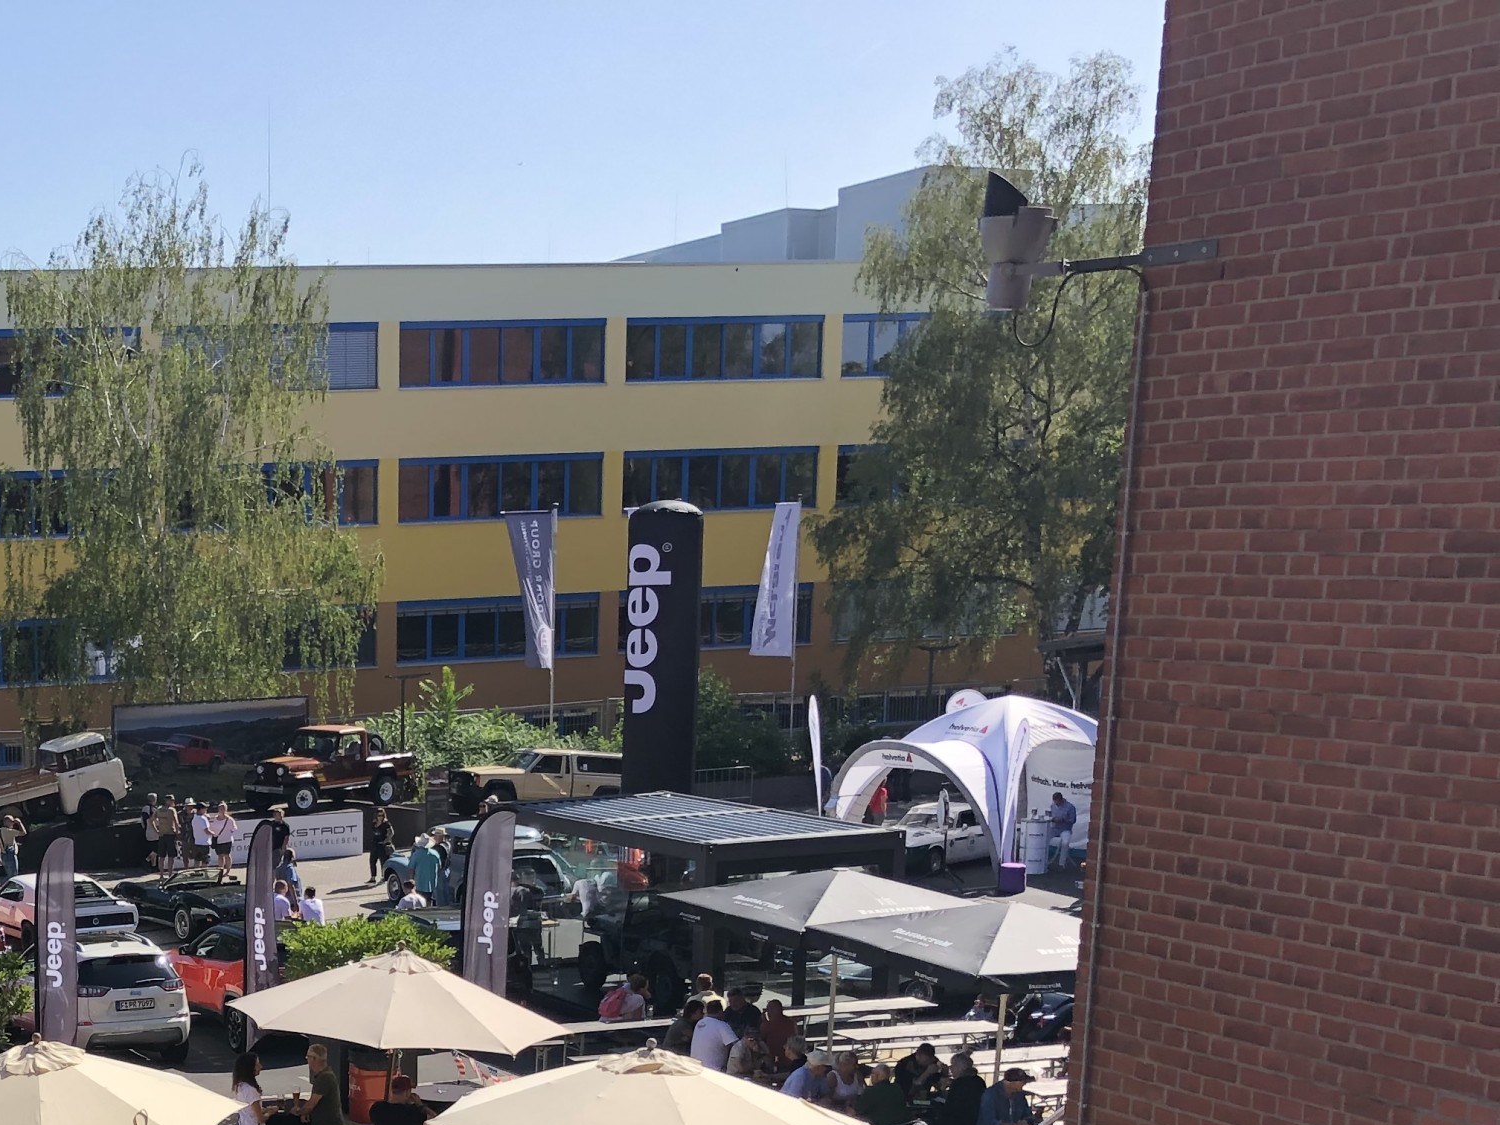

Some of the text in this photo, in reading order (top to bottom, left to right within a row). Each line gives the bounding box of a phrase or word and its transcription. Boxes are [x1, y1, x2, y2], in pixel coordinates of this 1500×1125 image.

[624, 543, 673, 714] Jeep
[46, 921, 67, 988] Jeep
[254, 907, 267, 971] Jeep
[478, 891, 499, 955] Jeep
